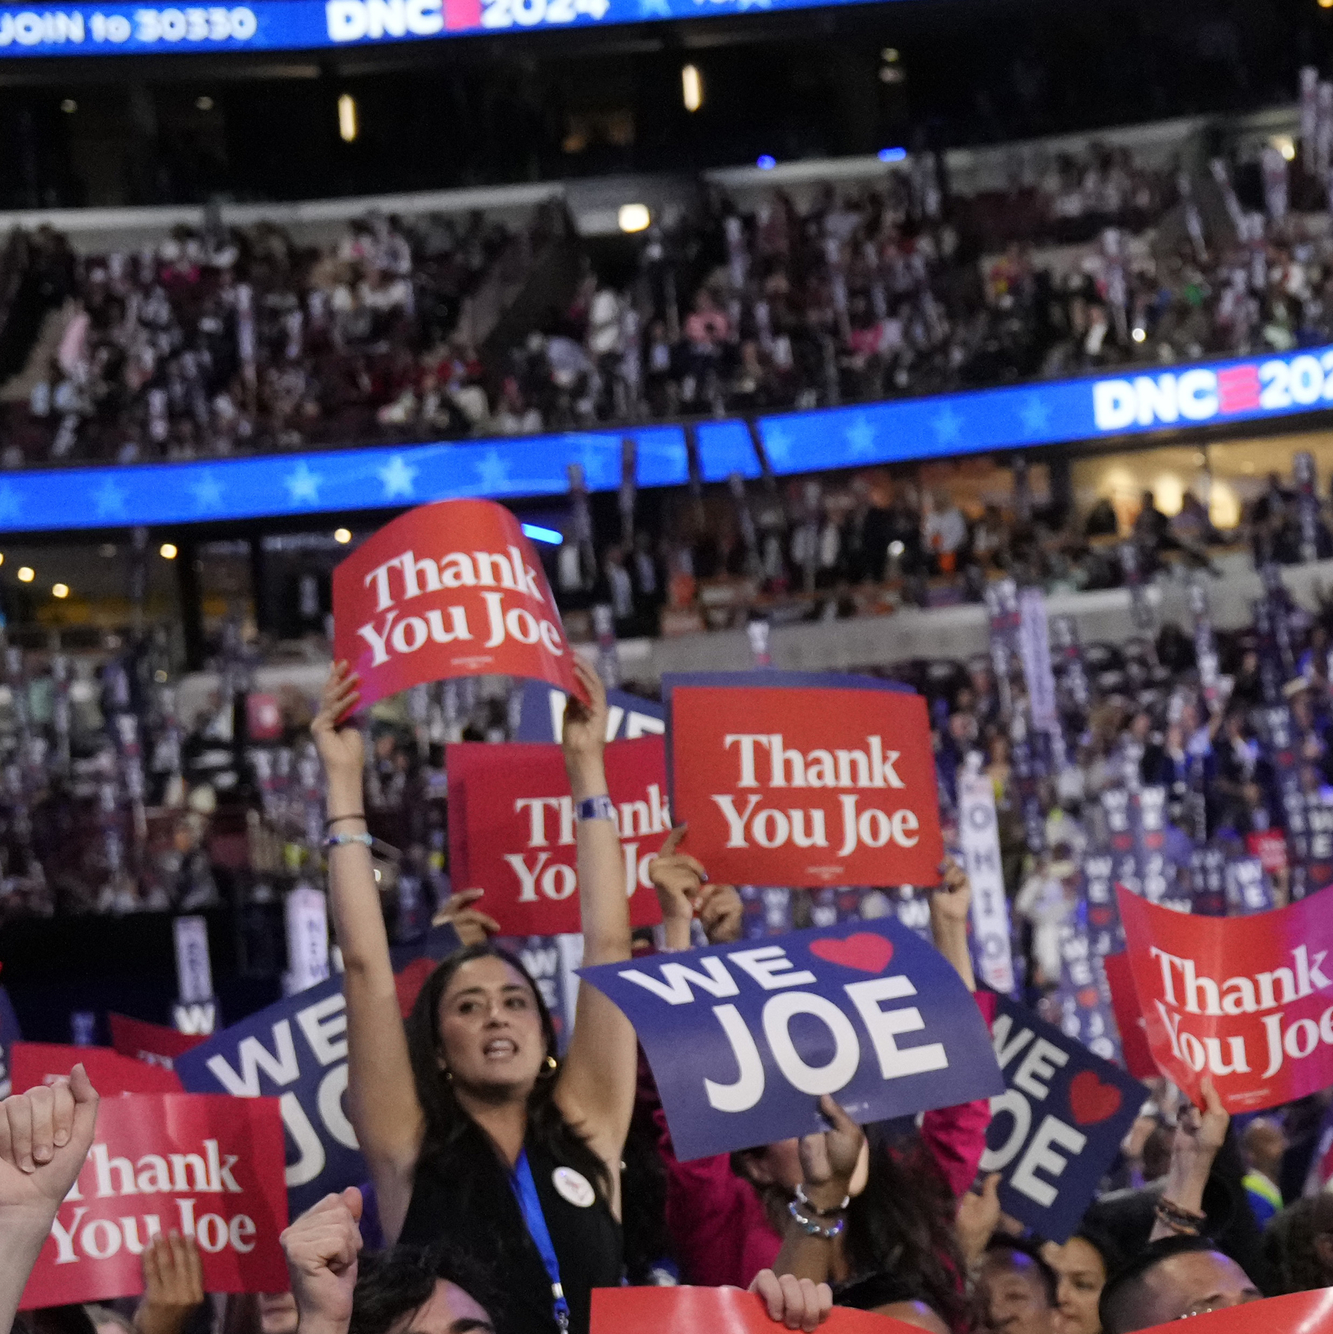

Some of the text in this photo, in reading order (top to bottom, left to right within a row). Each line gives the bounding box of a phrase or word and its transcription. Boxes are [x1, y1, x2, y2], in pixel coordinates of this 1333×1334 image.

[92, 15, 131, 41] to
[135, 7, 257, 41] 30330
[1092, 379, 1218, 430] DNC
[364, 543, 541, 612] Thank
[357, 591, 563, 668] You Joe
[724, 734, 905, 789] Thank
[711, 794, 920, 857] You Joe
[504, 852, 576, 900] Yo
[617, 946, 816, 1005] WE
[1150, 944, 1333, 1017] Thank
[206, 993, 348, 1097] WE
[704, 975, 949, 1113] JOE
[1153, 997, 1251, 1078] You
[51, 1206, 161, 1265] You
